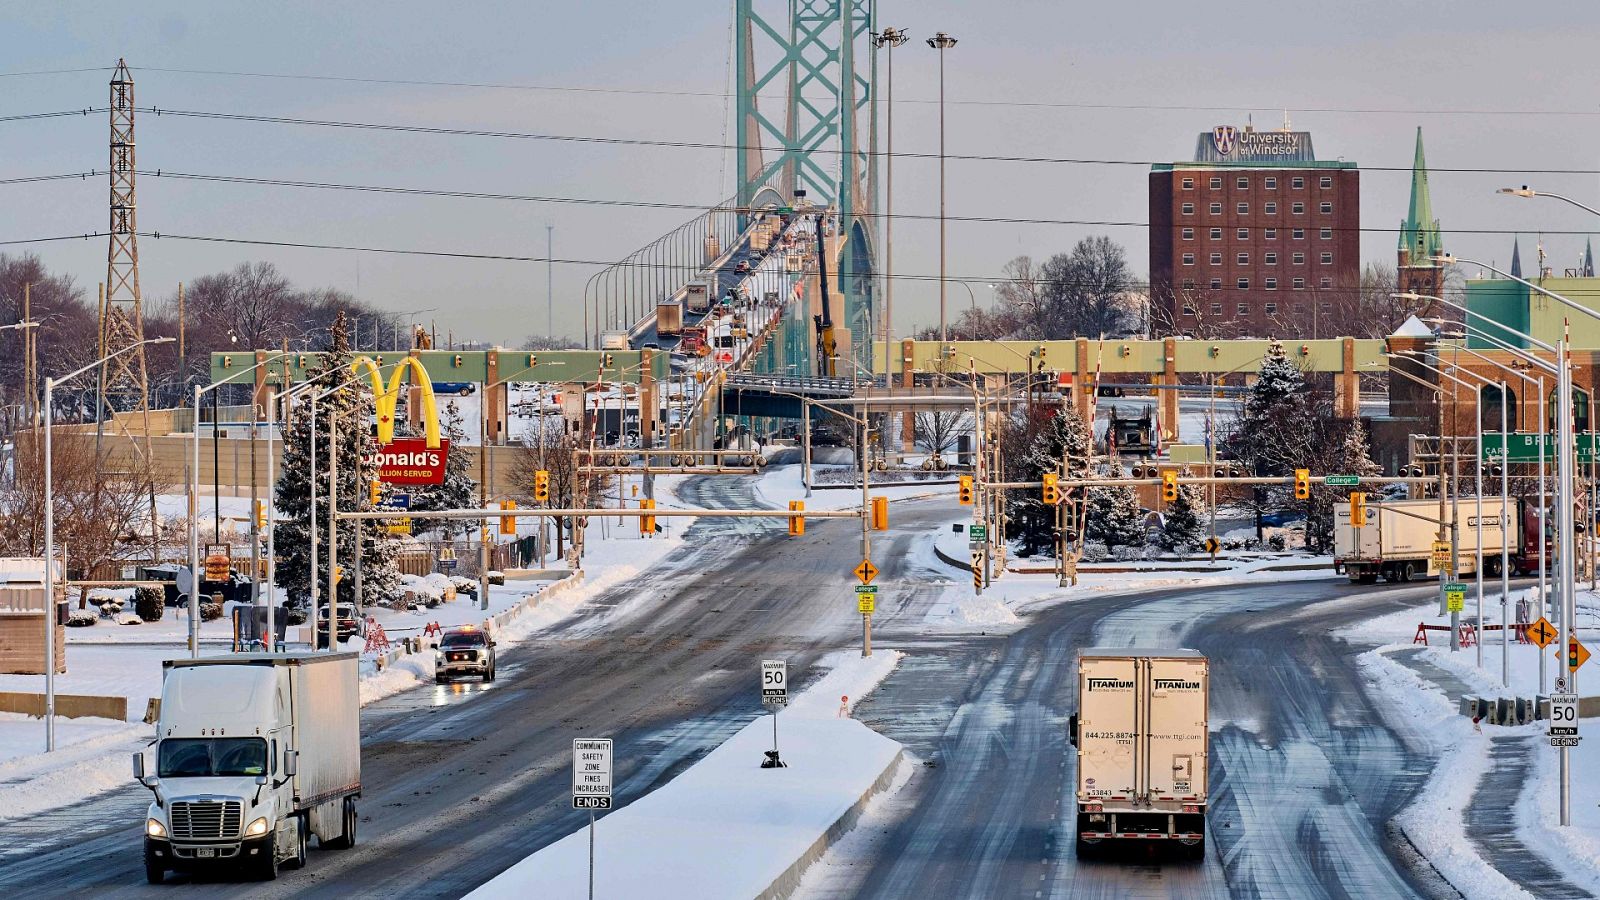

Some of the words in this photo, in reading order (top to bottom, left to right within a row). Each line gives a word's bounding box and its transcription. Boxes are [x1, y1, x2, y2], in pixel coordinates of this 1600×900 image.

[1240, 133, 1298, 146] University
[1240, 147, 1249, 155] of
[1249, 144, 1298, 155] Windsor
[1485, 447, 1510, 455] CARS
[360, 452, 440, 467] onald's
[403, 469, 433, 478] SERVED
[765, 671, 783, 684] 50
[1087, 678, 1134, 692] TITANIUM
[1153, 679, 1200, 690] TITANIUM
[1553, 706, 1575, 721] 50
[576, 742, 609, 750] COMMUNITY
[1551, 738, 1577, 746] BEGINS
[581, 753, 603, 761] SAFETY
[585, 763, 600, 771] ZONE
[575, 785, 609, 793] INCREASED
[576, 797, 608, 807] ENDS
